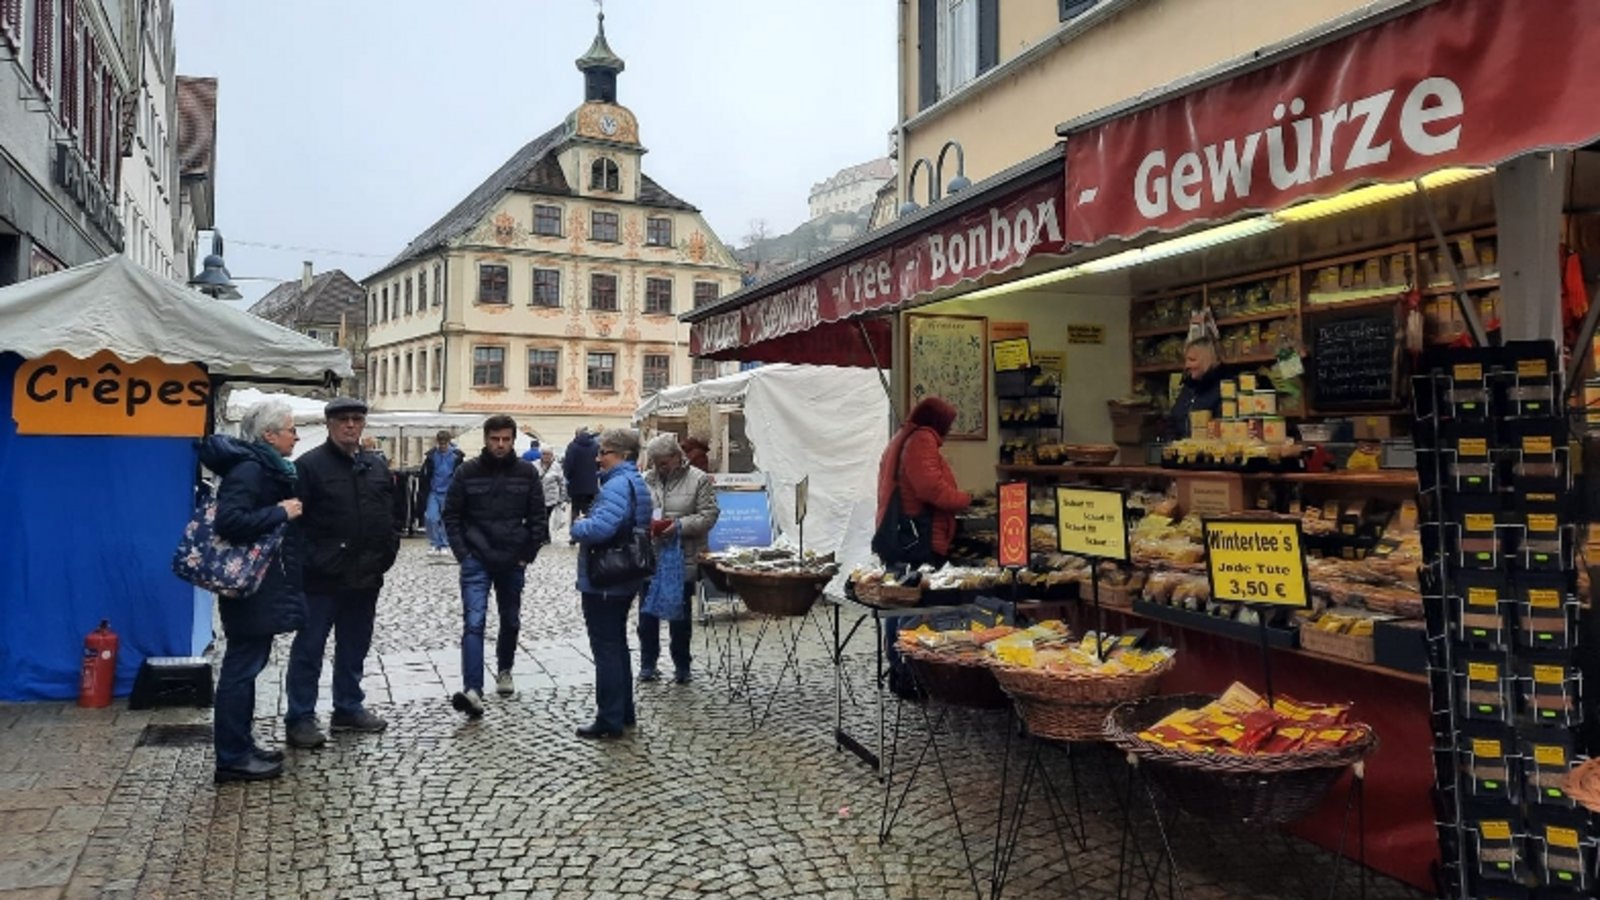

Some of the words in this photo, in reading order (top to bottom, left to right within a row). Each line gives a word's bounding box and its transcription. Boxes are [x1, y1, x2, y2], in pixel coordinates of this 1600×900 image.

[1134, 77, 1464, 219] Gewürze
[849, 260, 891, 303] Tee
[928, 197, 1064, 281] Bonbon
[26, 363, 209, 416] Crêpes
[1230, 580, 1268, 598] 3,50
[1275, 583, 1287, 598] €
